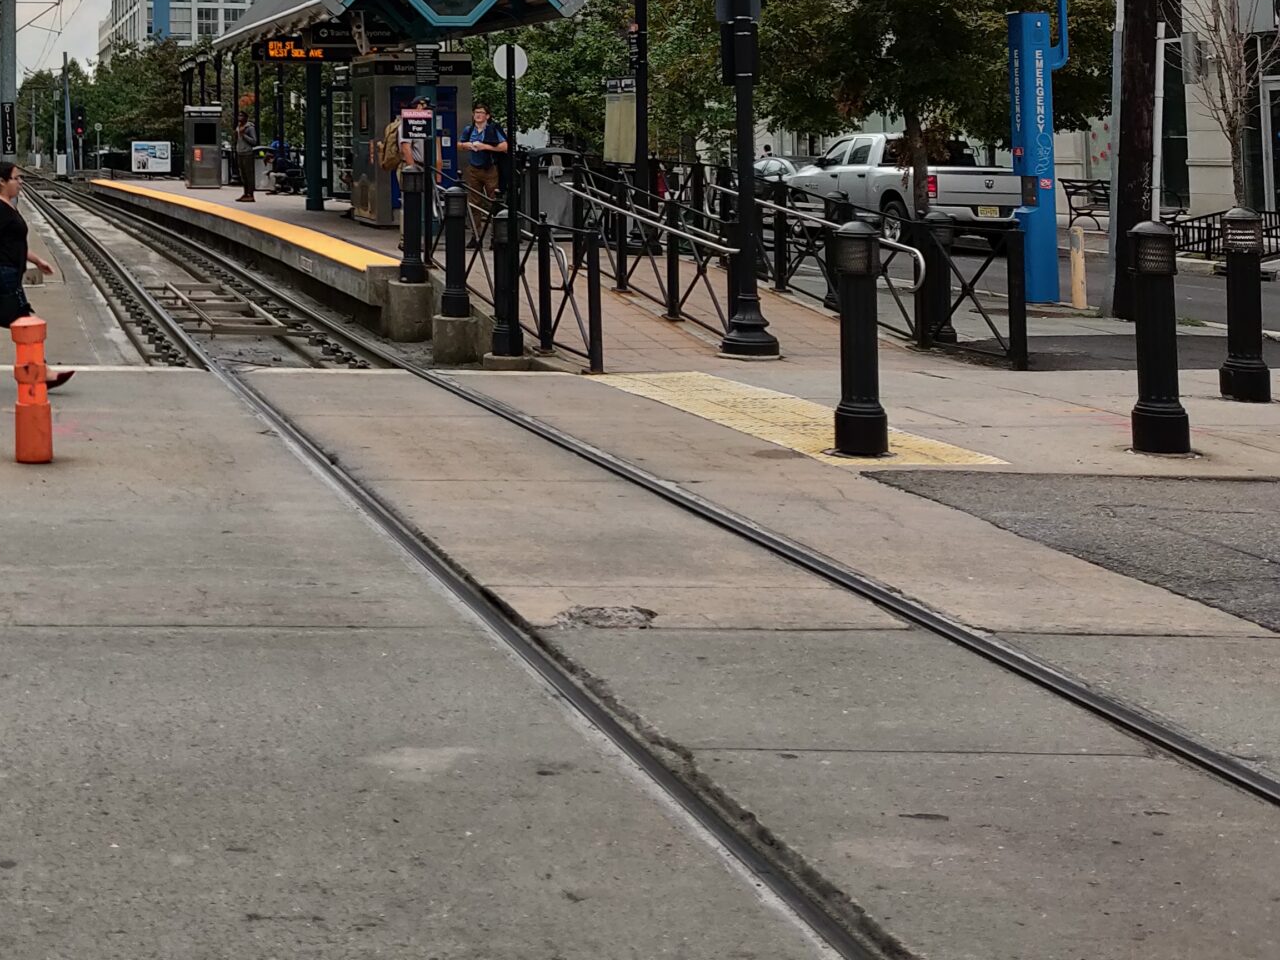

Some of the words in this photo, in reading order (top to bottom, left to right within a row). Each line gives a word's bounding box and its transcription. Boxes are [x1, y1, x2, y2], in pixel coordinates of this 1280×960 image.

[269, 49, 287, 57] WEST
[291, 49, 306, 57] SIDE
[309, 49, 323, 57] AVE
[393, 64, 415, 72] Marin
[1013, 49, 1021, 132] EMERGENCY
[1035, 49, 1044, 133] EMERGENCY
